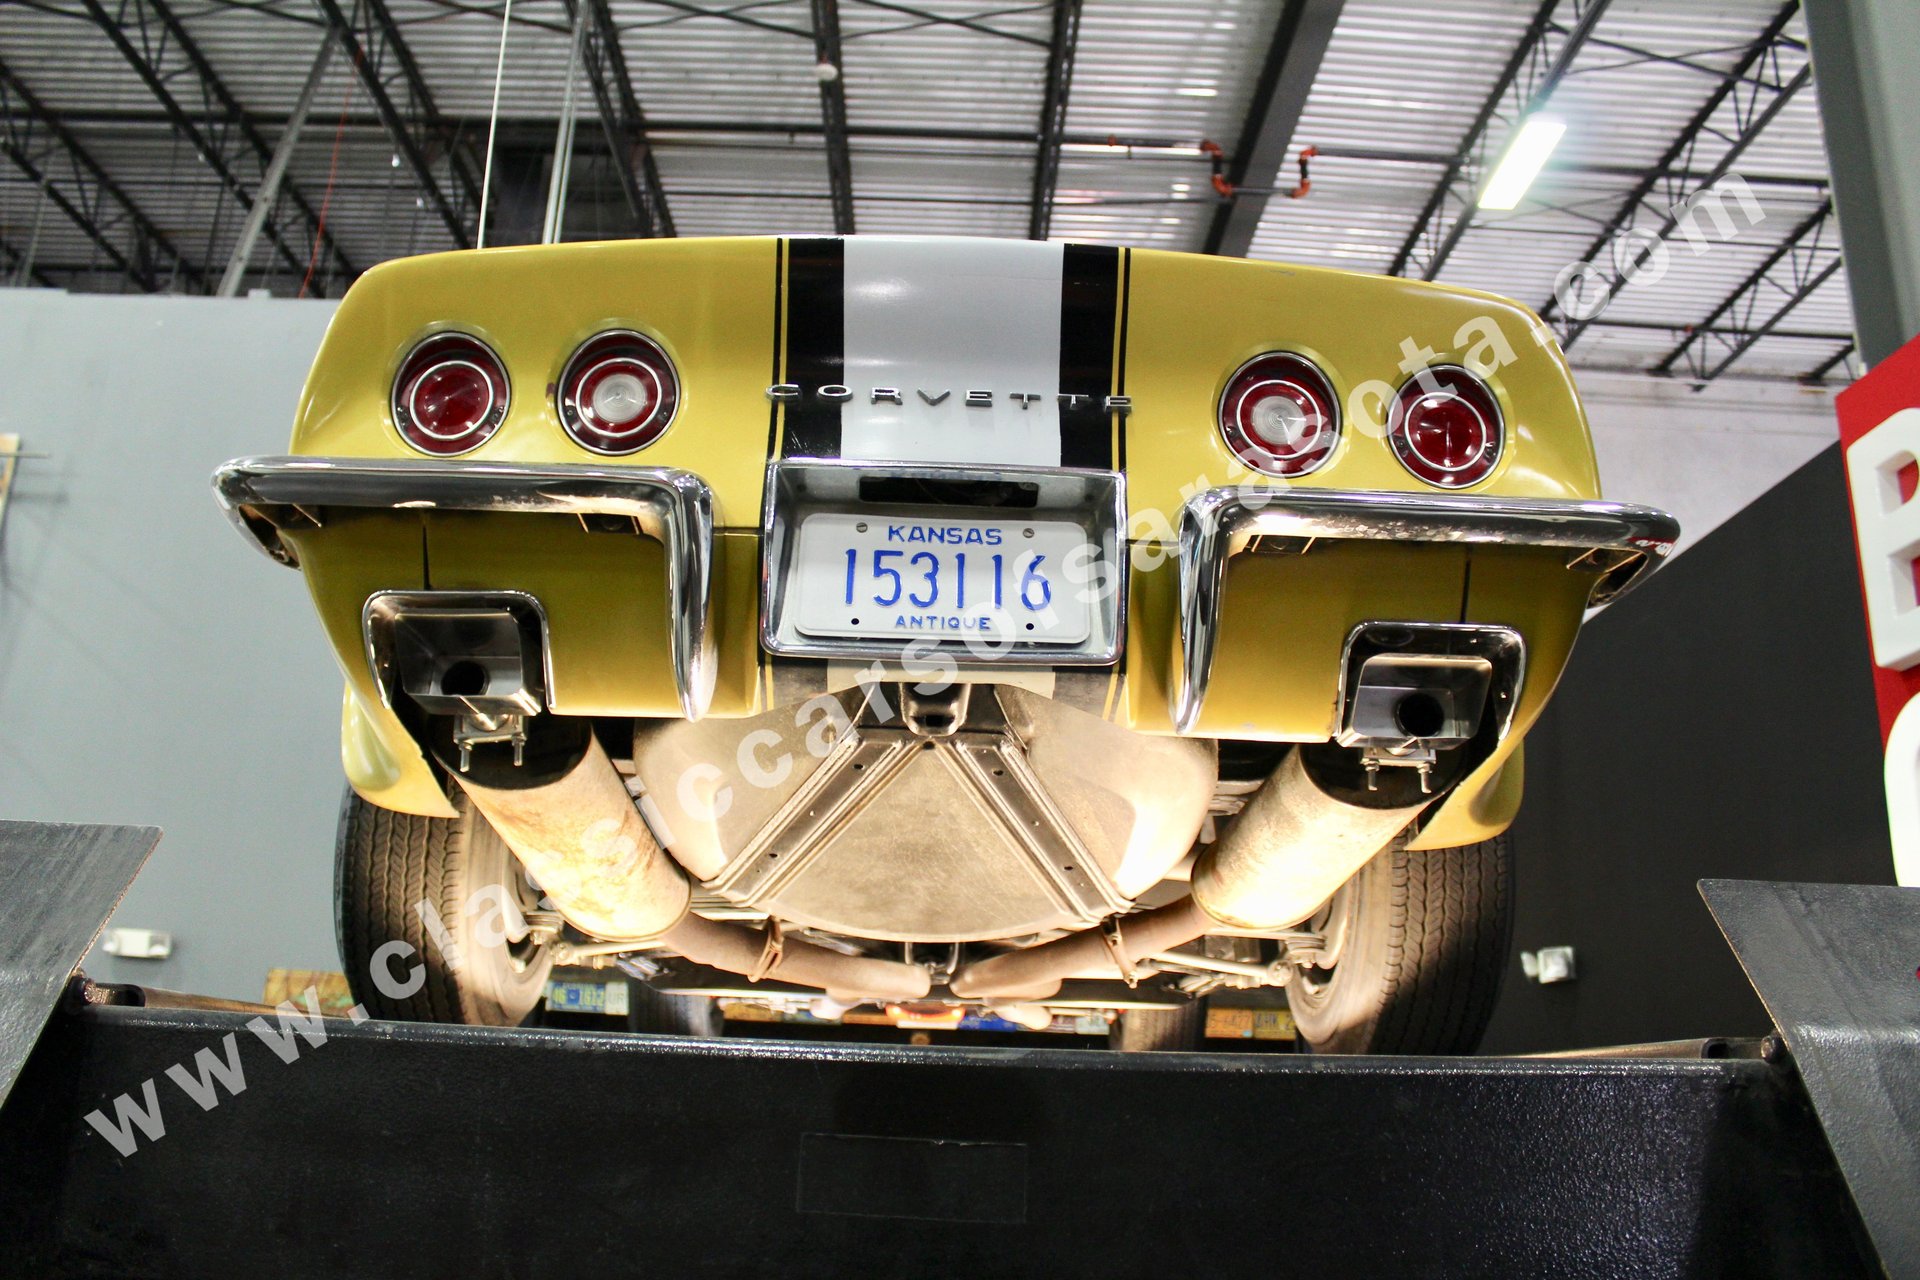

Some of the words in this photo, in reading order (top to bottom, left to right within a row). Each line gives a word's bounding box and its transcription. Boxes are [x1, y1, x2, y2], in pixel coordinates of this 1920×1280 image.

[765, 383, 1132, 413] CORVETTE
[888, 525, 1002, 545] KANSAS
[845, 548, 1051, 611] 153116
[894, 615, 991, 632] ANTIQUE
